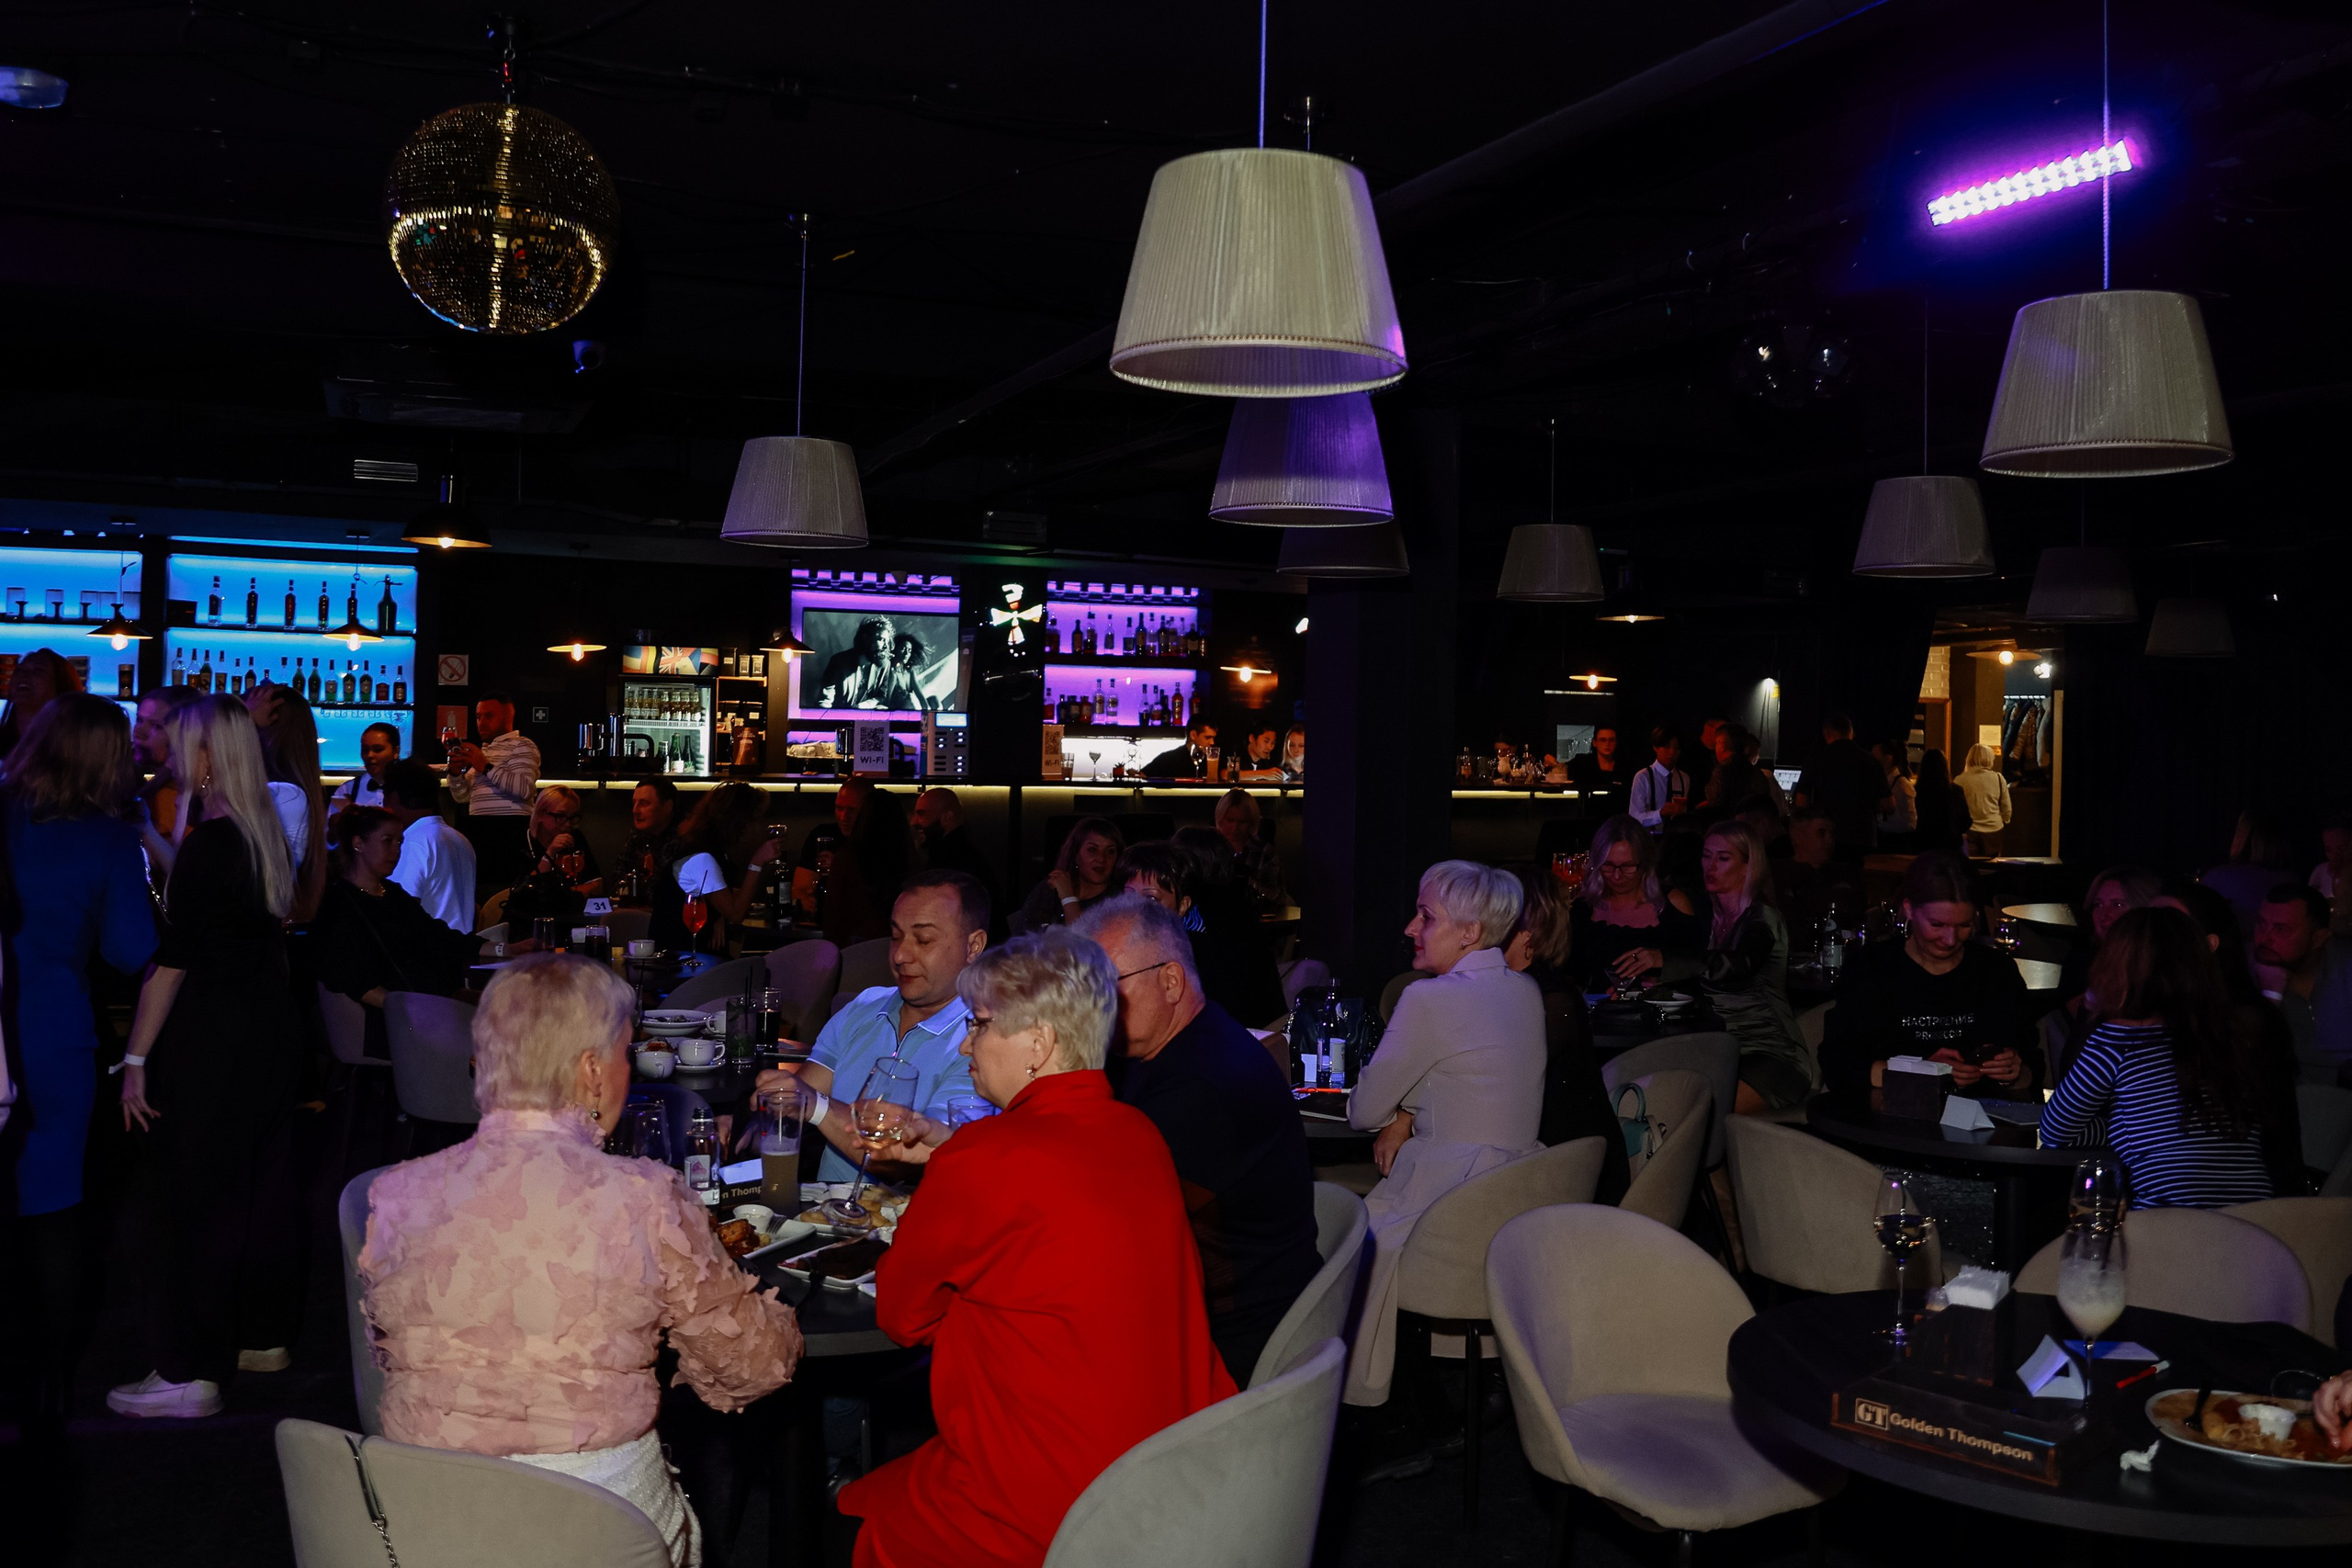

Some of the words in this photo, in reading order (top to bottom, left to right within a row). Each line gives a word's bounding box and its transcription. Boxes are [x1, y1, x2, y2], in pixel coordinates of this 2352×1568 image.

[594, 901, 606, 910] 31
[1915, 1029, 1962, 1040] PRECCO
[730, 1186, 762, 1198] Thomp
[1857, 1402, 1887, 1427] GT
[1889, 1412, 1945, 1438] Golden
[1947, 1427, 2035, 1461] Thompson
